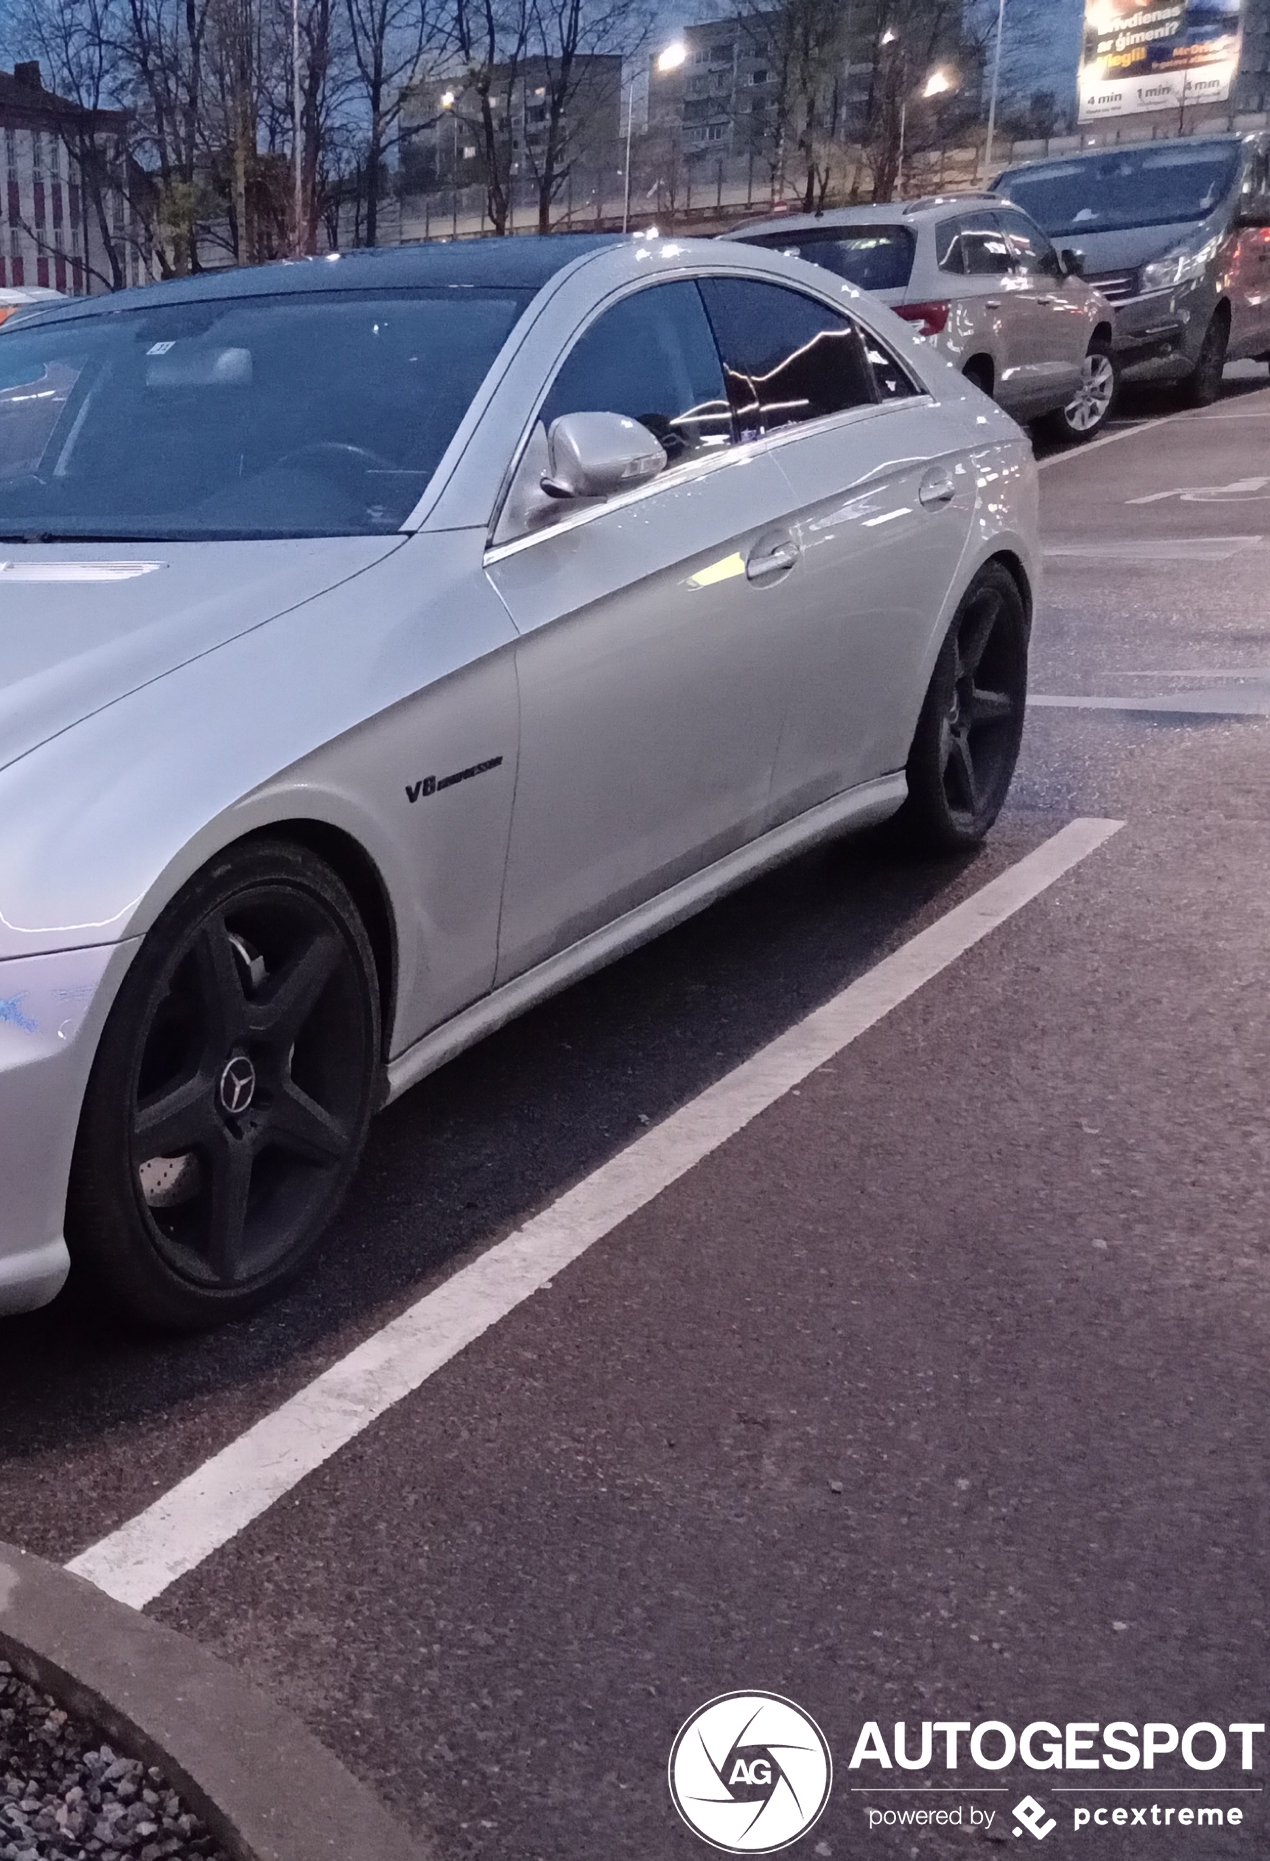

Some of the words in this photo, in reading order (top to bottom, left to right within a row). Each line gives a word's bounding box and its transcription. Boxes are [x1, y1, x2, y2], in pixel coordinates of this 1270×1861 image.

[1097, 40, 1114, 53] ar
[1115, 21, 1179, 52] ģimeni?
[1087, 96, 1095, 105] 4
[1098, 92, 1122, 104] min
[1137, 88, 1143, 98] 1
[1145, 84, 1171, 97] min
[405, 775, 436, 803] V8
